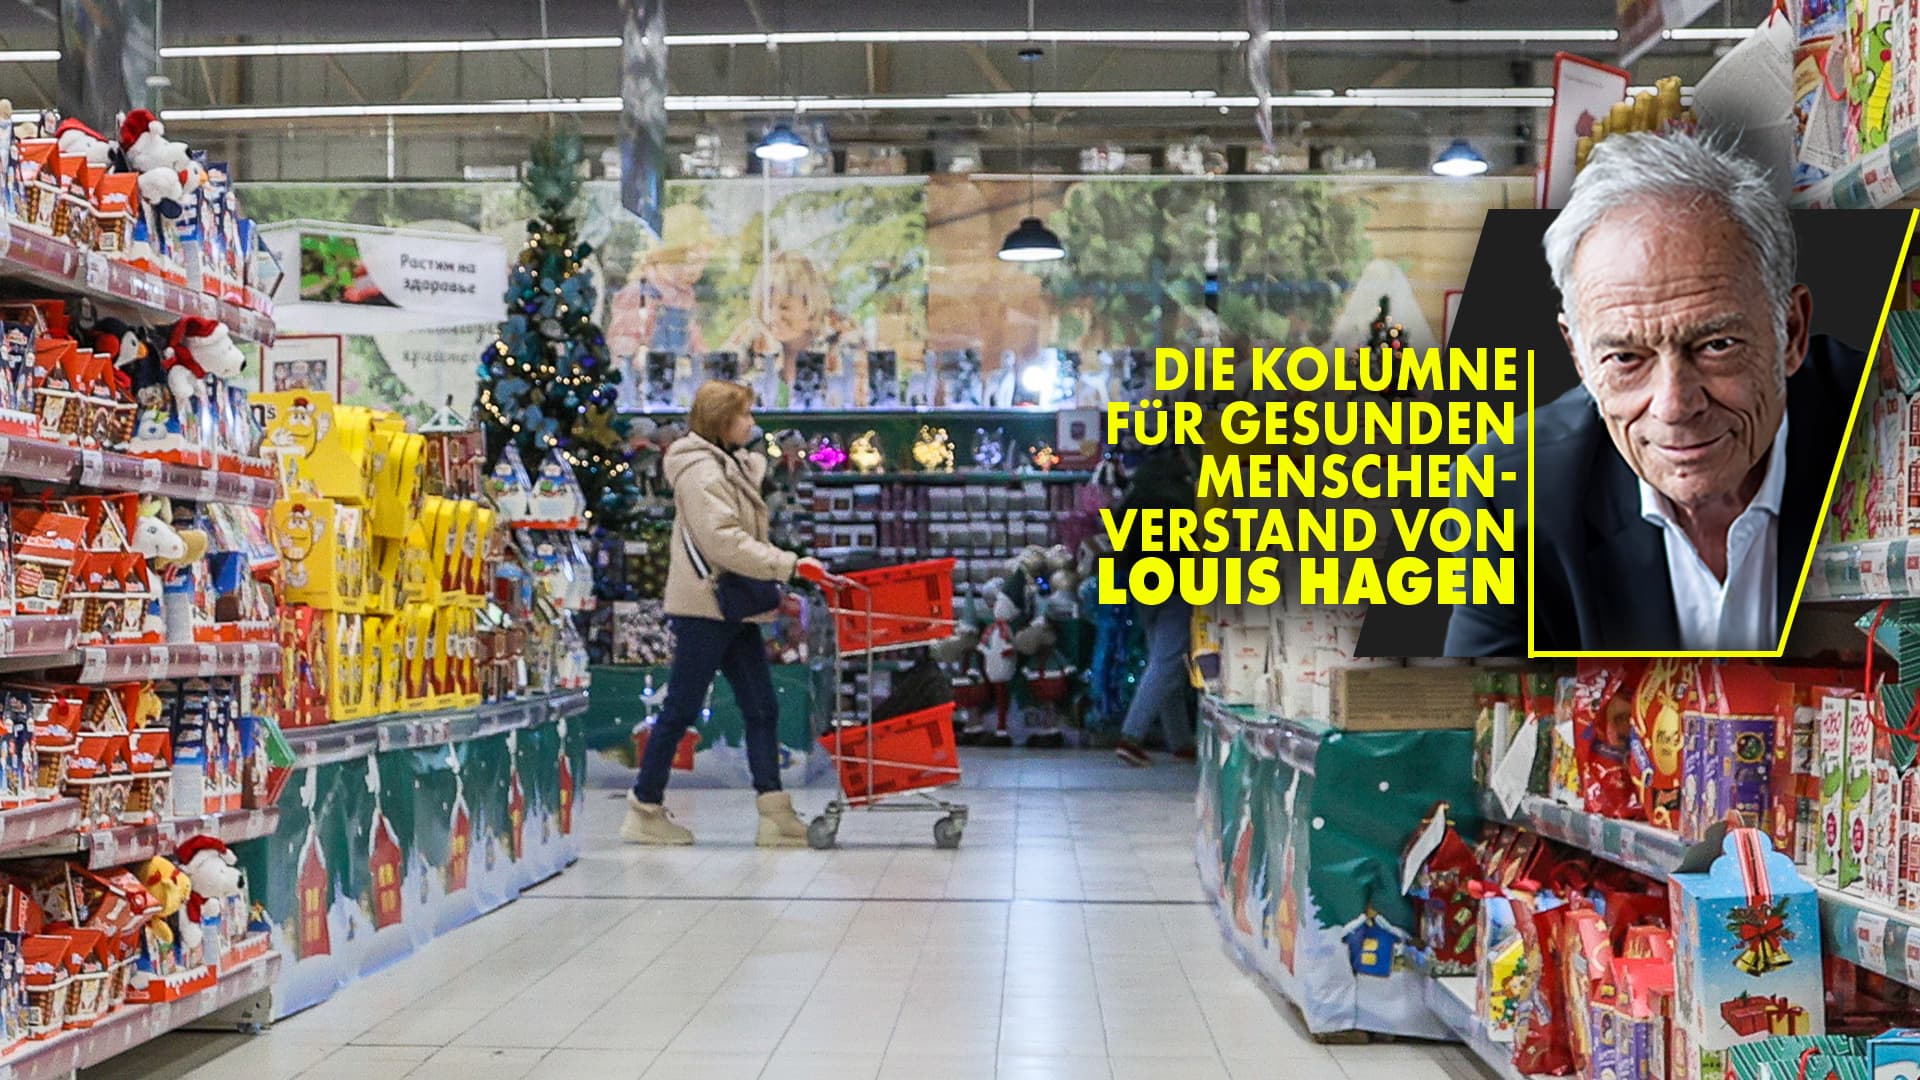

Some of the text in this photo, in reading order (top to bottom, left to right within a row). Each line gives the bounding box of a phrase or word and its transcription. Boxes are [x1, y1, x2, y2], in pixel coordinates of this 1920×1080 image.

[400, 253, 477, 275] Растим на
[403, 278, 477, 294] здоровье
